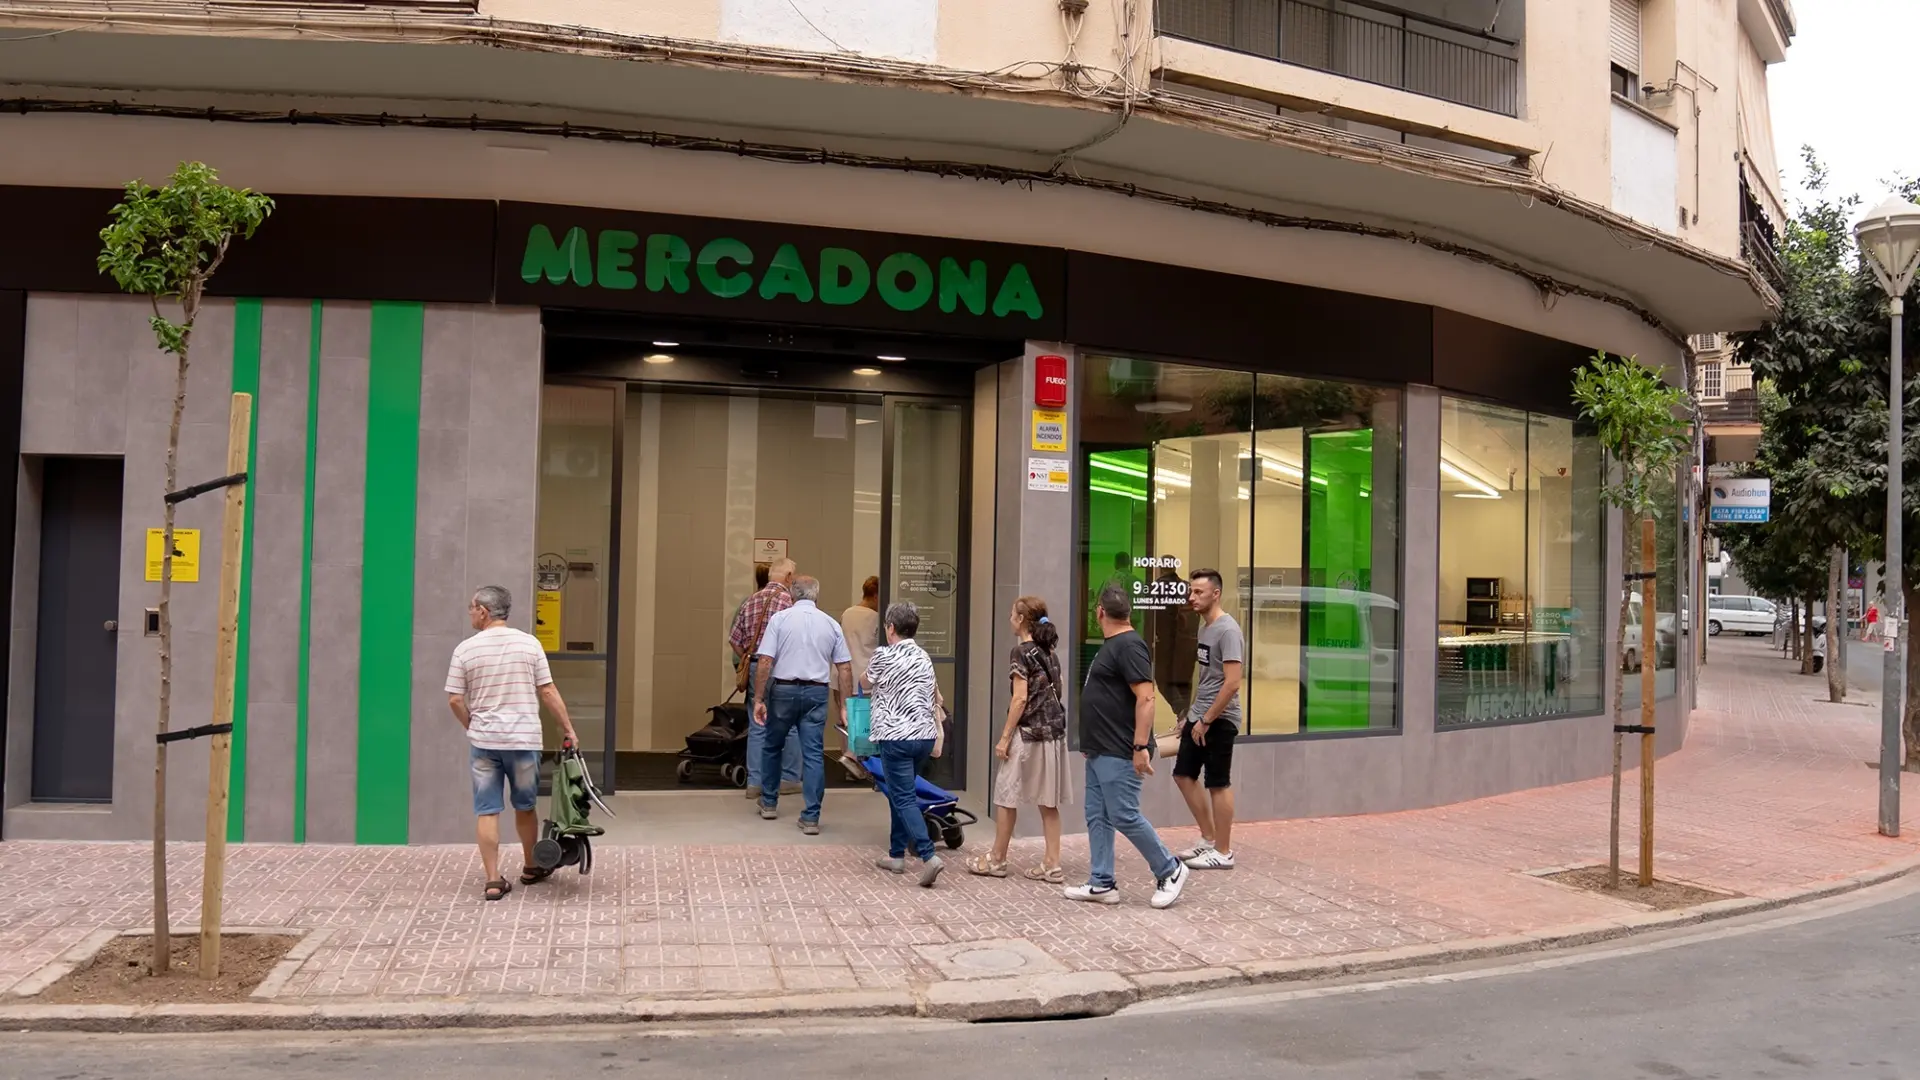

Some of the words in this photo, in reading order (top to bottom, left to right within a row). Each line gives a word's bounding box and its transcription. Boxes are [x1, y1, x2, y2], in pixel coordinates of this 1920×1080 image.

[521, 223, 1044, 320] MERCADONA
[1045, 376, 1066, 385] FUEGO
[1036, 433, 1062, 441] INCENDIOS
[1133, 557, 1182, 568] HORARIO
[1133, 581, 1142, 594] 9
[1143, 584, 1149, 594] a
[1150, 581, 1186, 595] 21:30
[1160, 596, 1186, 604] SÁBADO
